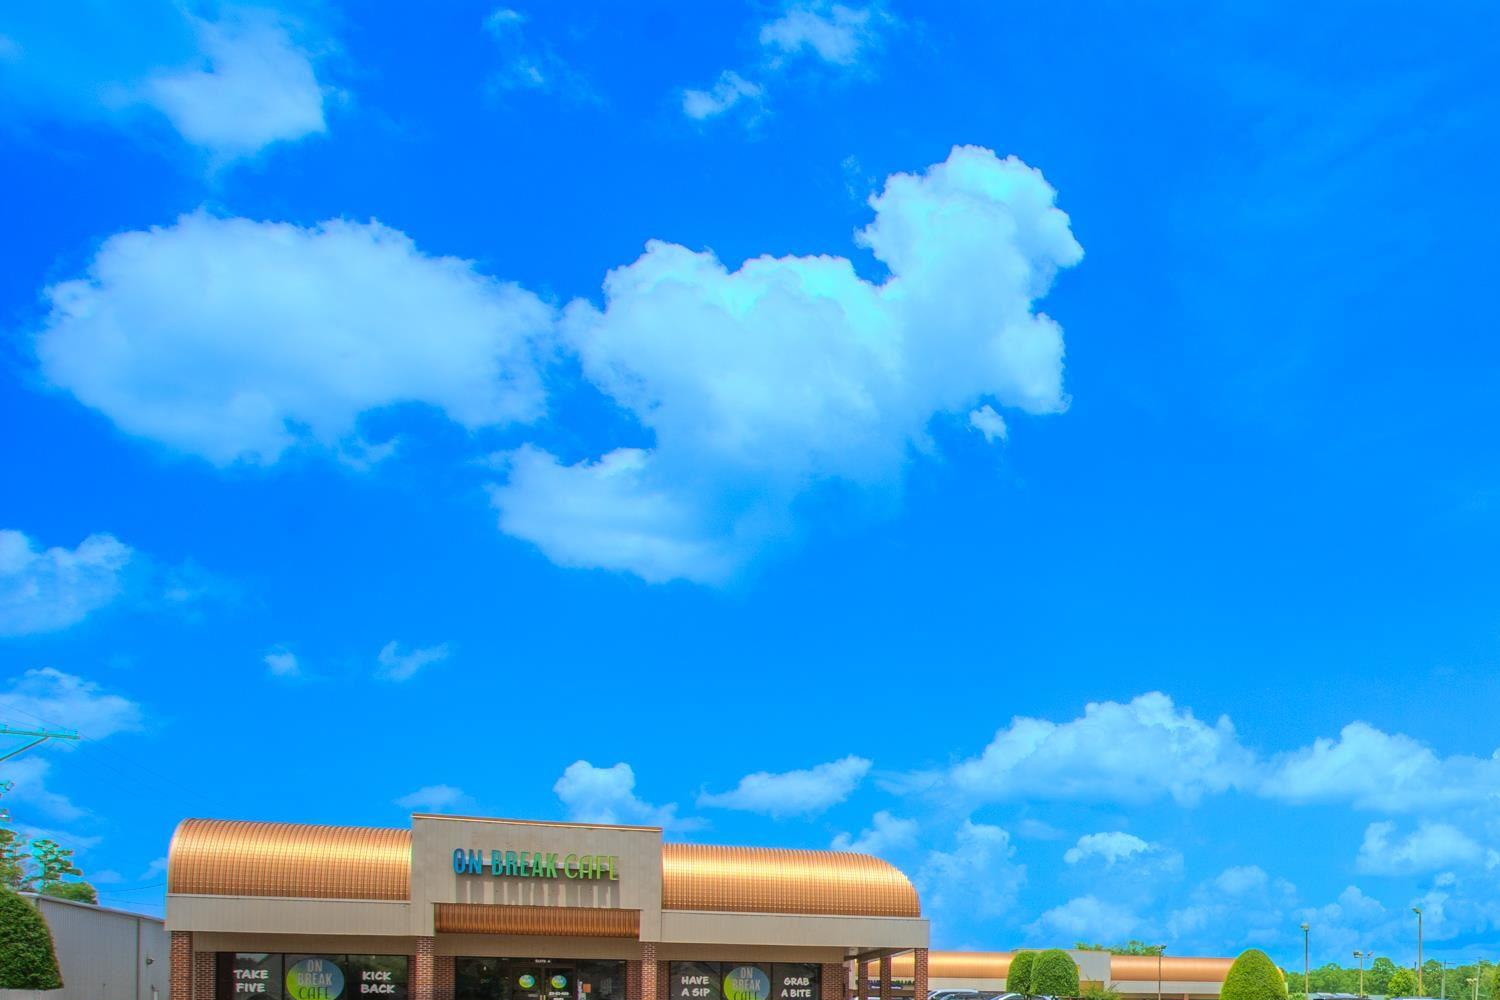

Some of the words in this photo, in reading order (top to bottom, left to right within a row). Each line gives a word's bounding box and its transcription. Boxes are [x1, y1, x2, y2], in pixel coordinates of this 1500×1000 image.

[452, 848, 483, 876] ON
[491, 849, 559, 879] BREAK
[564, 853, 620, 881] CAFE
[307, 960, 323, 971] ON
[233, 969, 269, 980] TAKE
[362, 971, 392, 981] KICK
[740, 968, 753, 978] ON
[297, 973, 333, 986] BREAK
[681, 976, 710, 985] HAVE
[783, 977, 810, 986] GRAB
[236, 983, 266, 993] FIVE
[360, 984, 395, 994] BACK
[732, 979, 761, 991] BREAK
[299, 987, 329, 1000] CAFE
[681, 988, 690, 997] A
[692, 988, 711, 997] SIP
[781, 989, 789, 998] A
[790, 989, 812, 998] BITE
